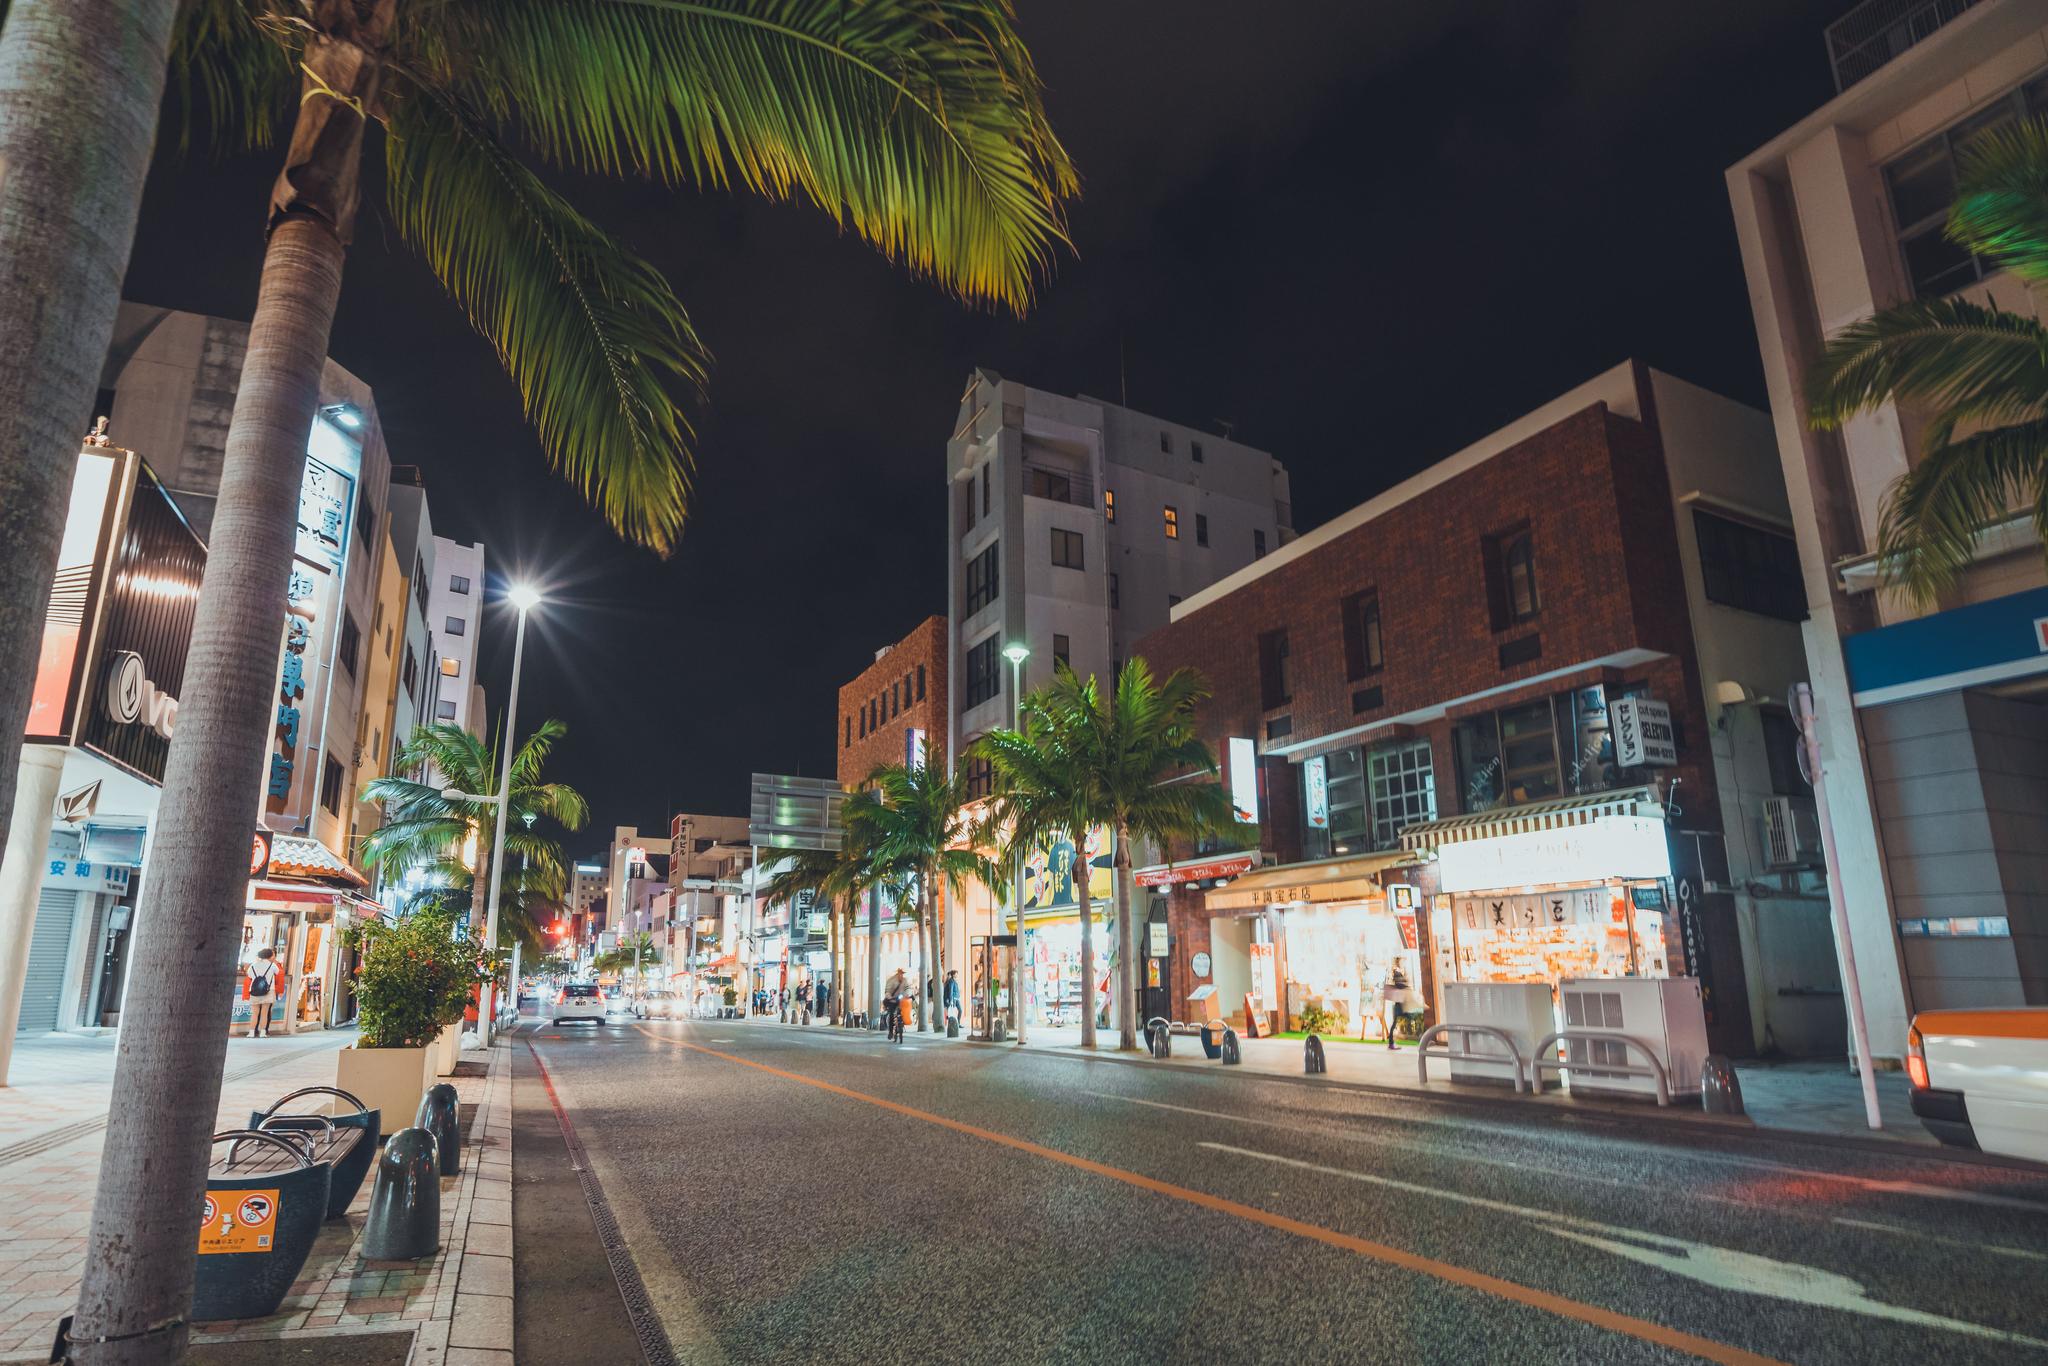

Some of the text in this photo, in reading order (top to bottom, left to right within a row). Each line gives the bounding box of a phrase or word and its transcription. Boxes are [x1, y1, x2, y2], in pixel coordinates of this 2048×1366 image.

[1618, 704, 1636, 761] セレクション
[1641, 721, 1672, 742] SELECTION
[50, 860, 91, 878] 安和
